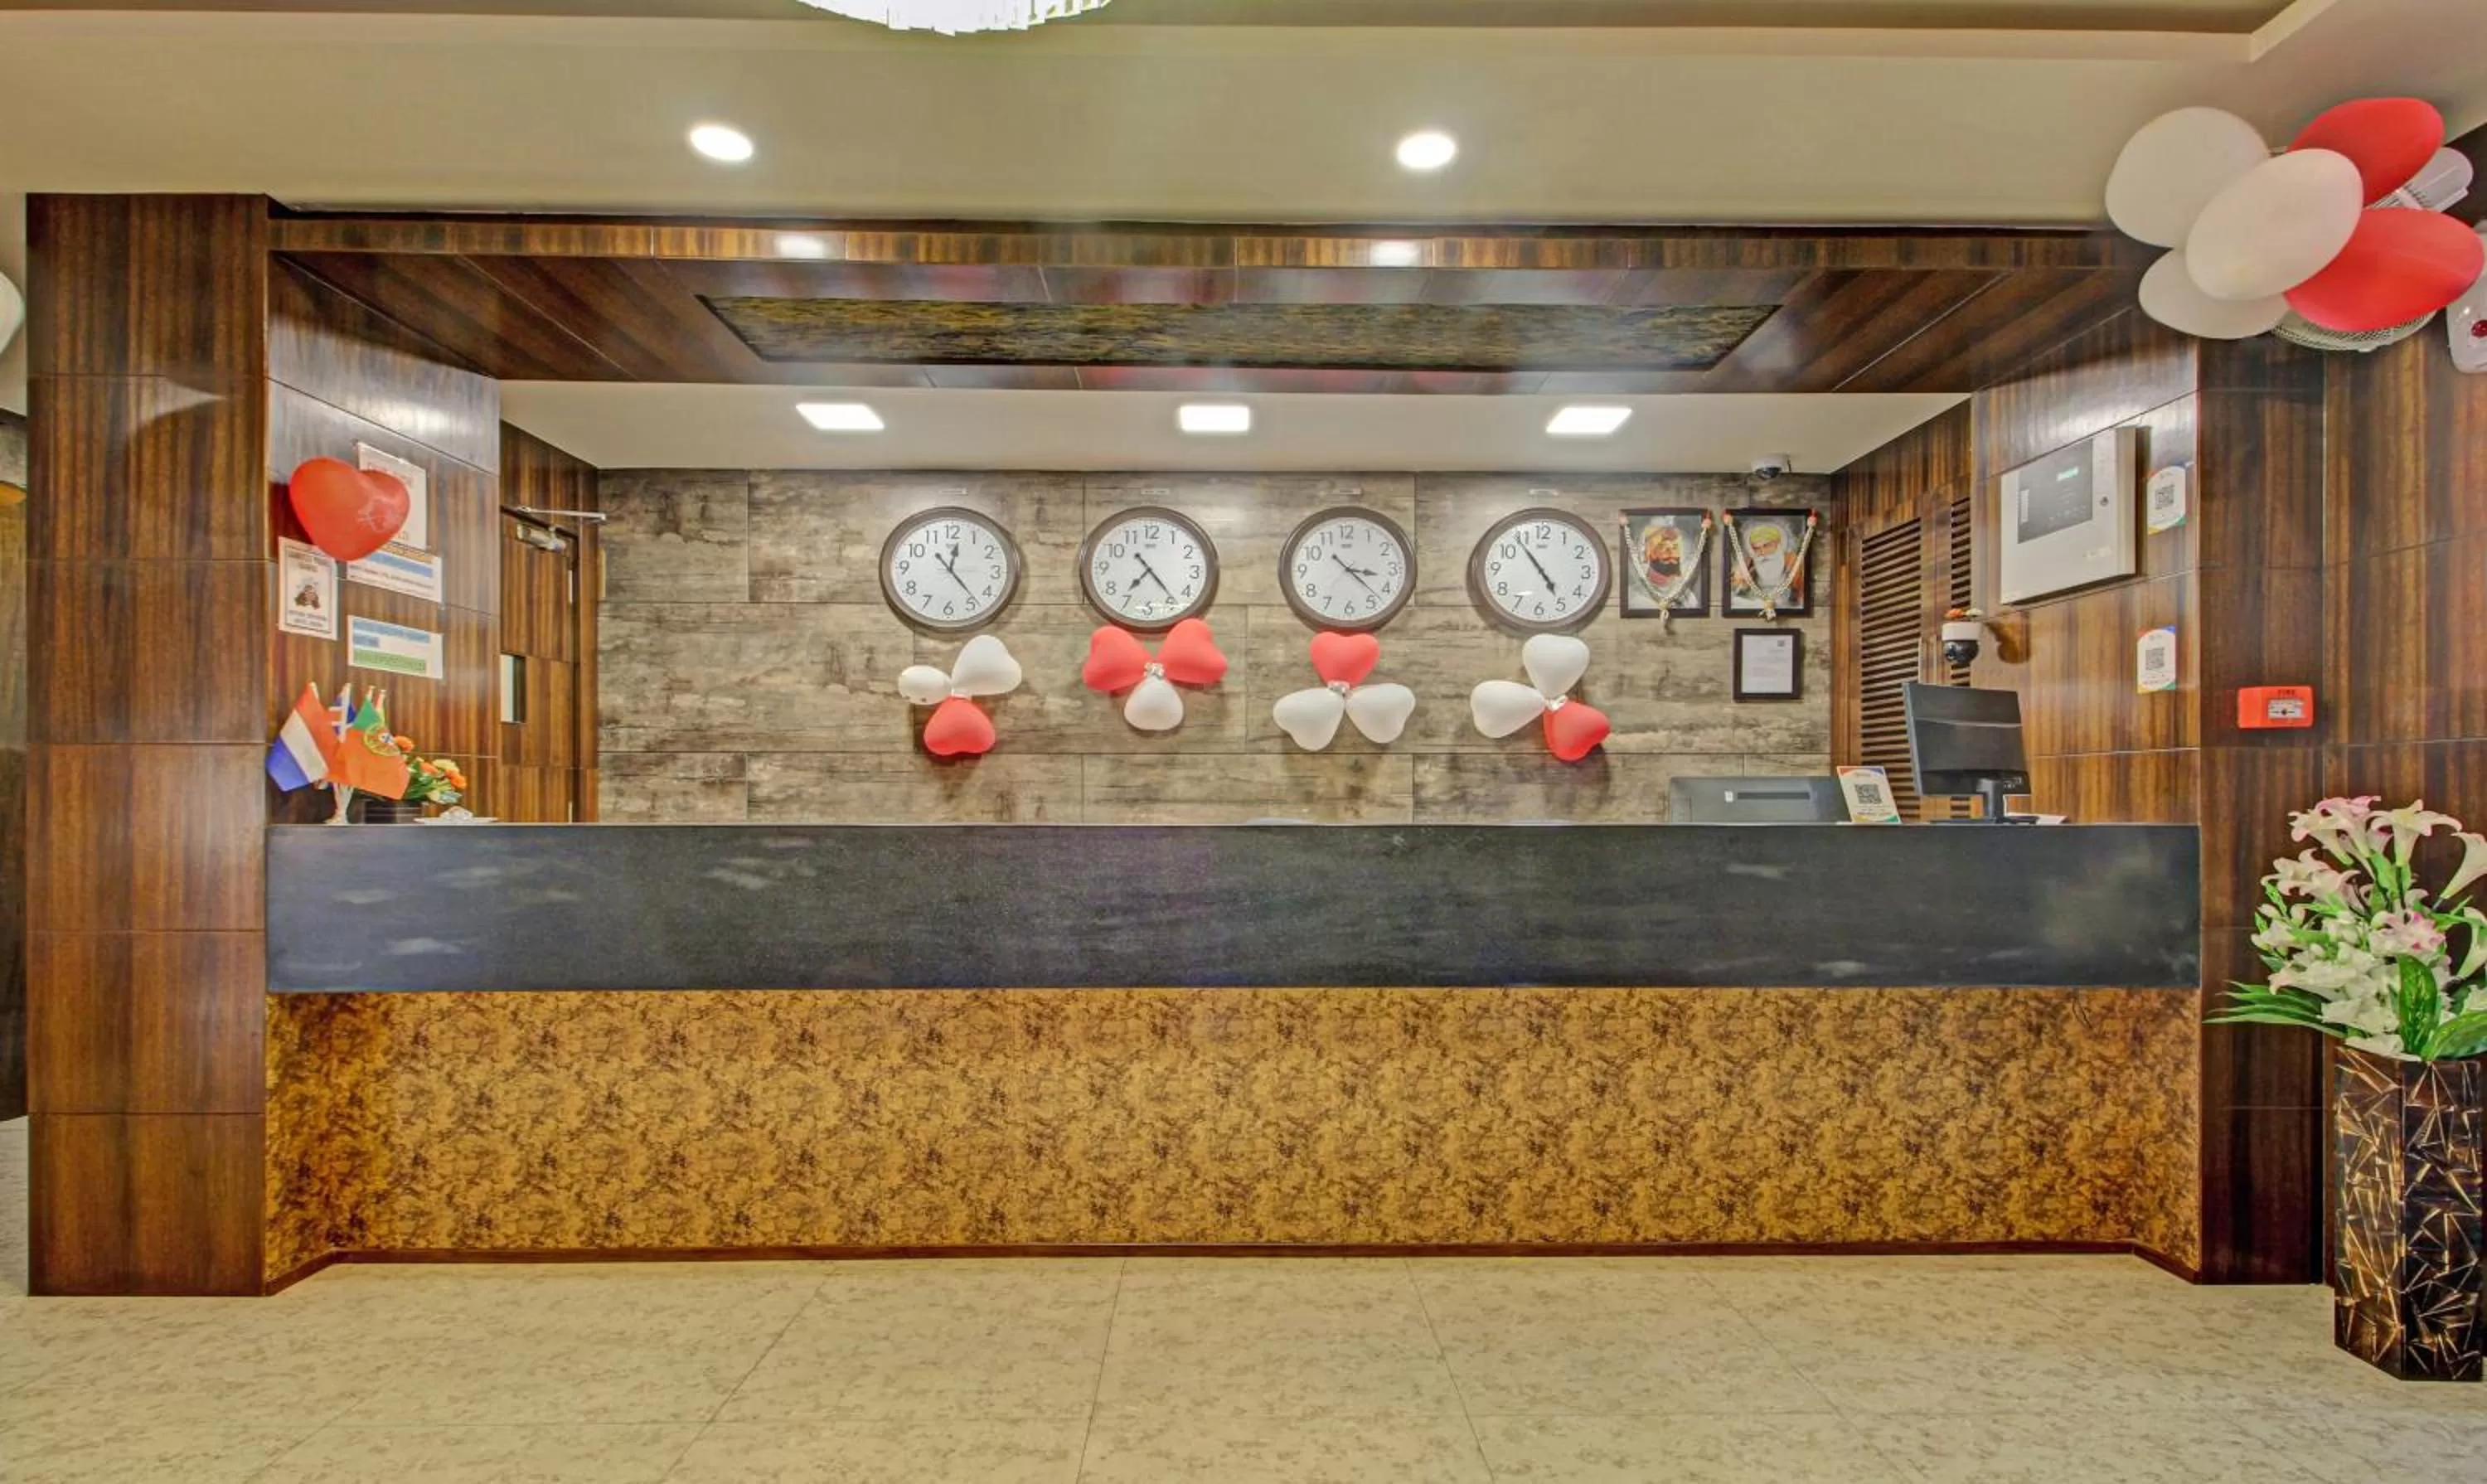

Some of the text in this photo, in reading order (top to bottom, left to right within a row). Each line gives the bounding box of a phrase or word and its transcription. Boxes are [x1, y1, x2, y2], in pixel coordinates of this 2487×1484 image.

[925, 531, 938, 544] 11
[944, 525, 960, 539] 12
[971, 531, 976, 544] 1
[1124, 531, 1137, 544] 11
[1143, 525, 1160, 539] 12
[1170, 531, 1175, 544] 1
[1320, 531, 1333, 545] 11
[1339, 525, 1354, 539] 12
[1365, 530, 1370, 542] 1
[1535, 526, 1550, 539] 12
[1562, 532, 1566, 544] 1
[909, 544, 925, 557] 10
[984, 546, 995, 559] 2
[1106, 544, 1124, 558] 10
[1183, 545, 1193, 559] 2
[1305, 546, 1321, 560] 10
[1379, 542, 1389, 556] 2
[1500, 544, 1515, 559] 10
[1575, 546, 1584, 559] 2
[899, 560, 909, 575] 9
[990, 565, 1001, 579] 3
[1098, 560, 1109, 575] 9
[1189, 565, 1200, 579] 3
[1297, 564, 1307, 578] 9
[1388, 562, 1398, 576] 3
[1491, 561, 1501, 575] 9
[1581, 565, 1591, 580] 3
[906, 580, 916, 595] 8
[982, 585, 991, 597] 4
[1106, 581, 1116, 595] 8
[1181, 584, 1190, 597] 4
[1306, 583, 1316, 597] 8
[1382, 581, 1390, 594] 4
[1497, 581, 1508, 595] 8
[1573, 585, 1582, 598] 4
[923, 594, 933, 610] 7
[943, 601, 953, 615] 6
[966, 596, 976, 611] 5
[1122, 594, 1132, 610] 7
[1323, 596, 1331, 610] 7
[1344, 600, 1355, 614] 6
[1366, 595, 1376, 609] 5
[1514, 595, 1523, 609] 7
[1534, 602, 1544, 615] 6
[1556, 599, 1566, 611] 5
